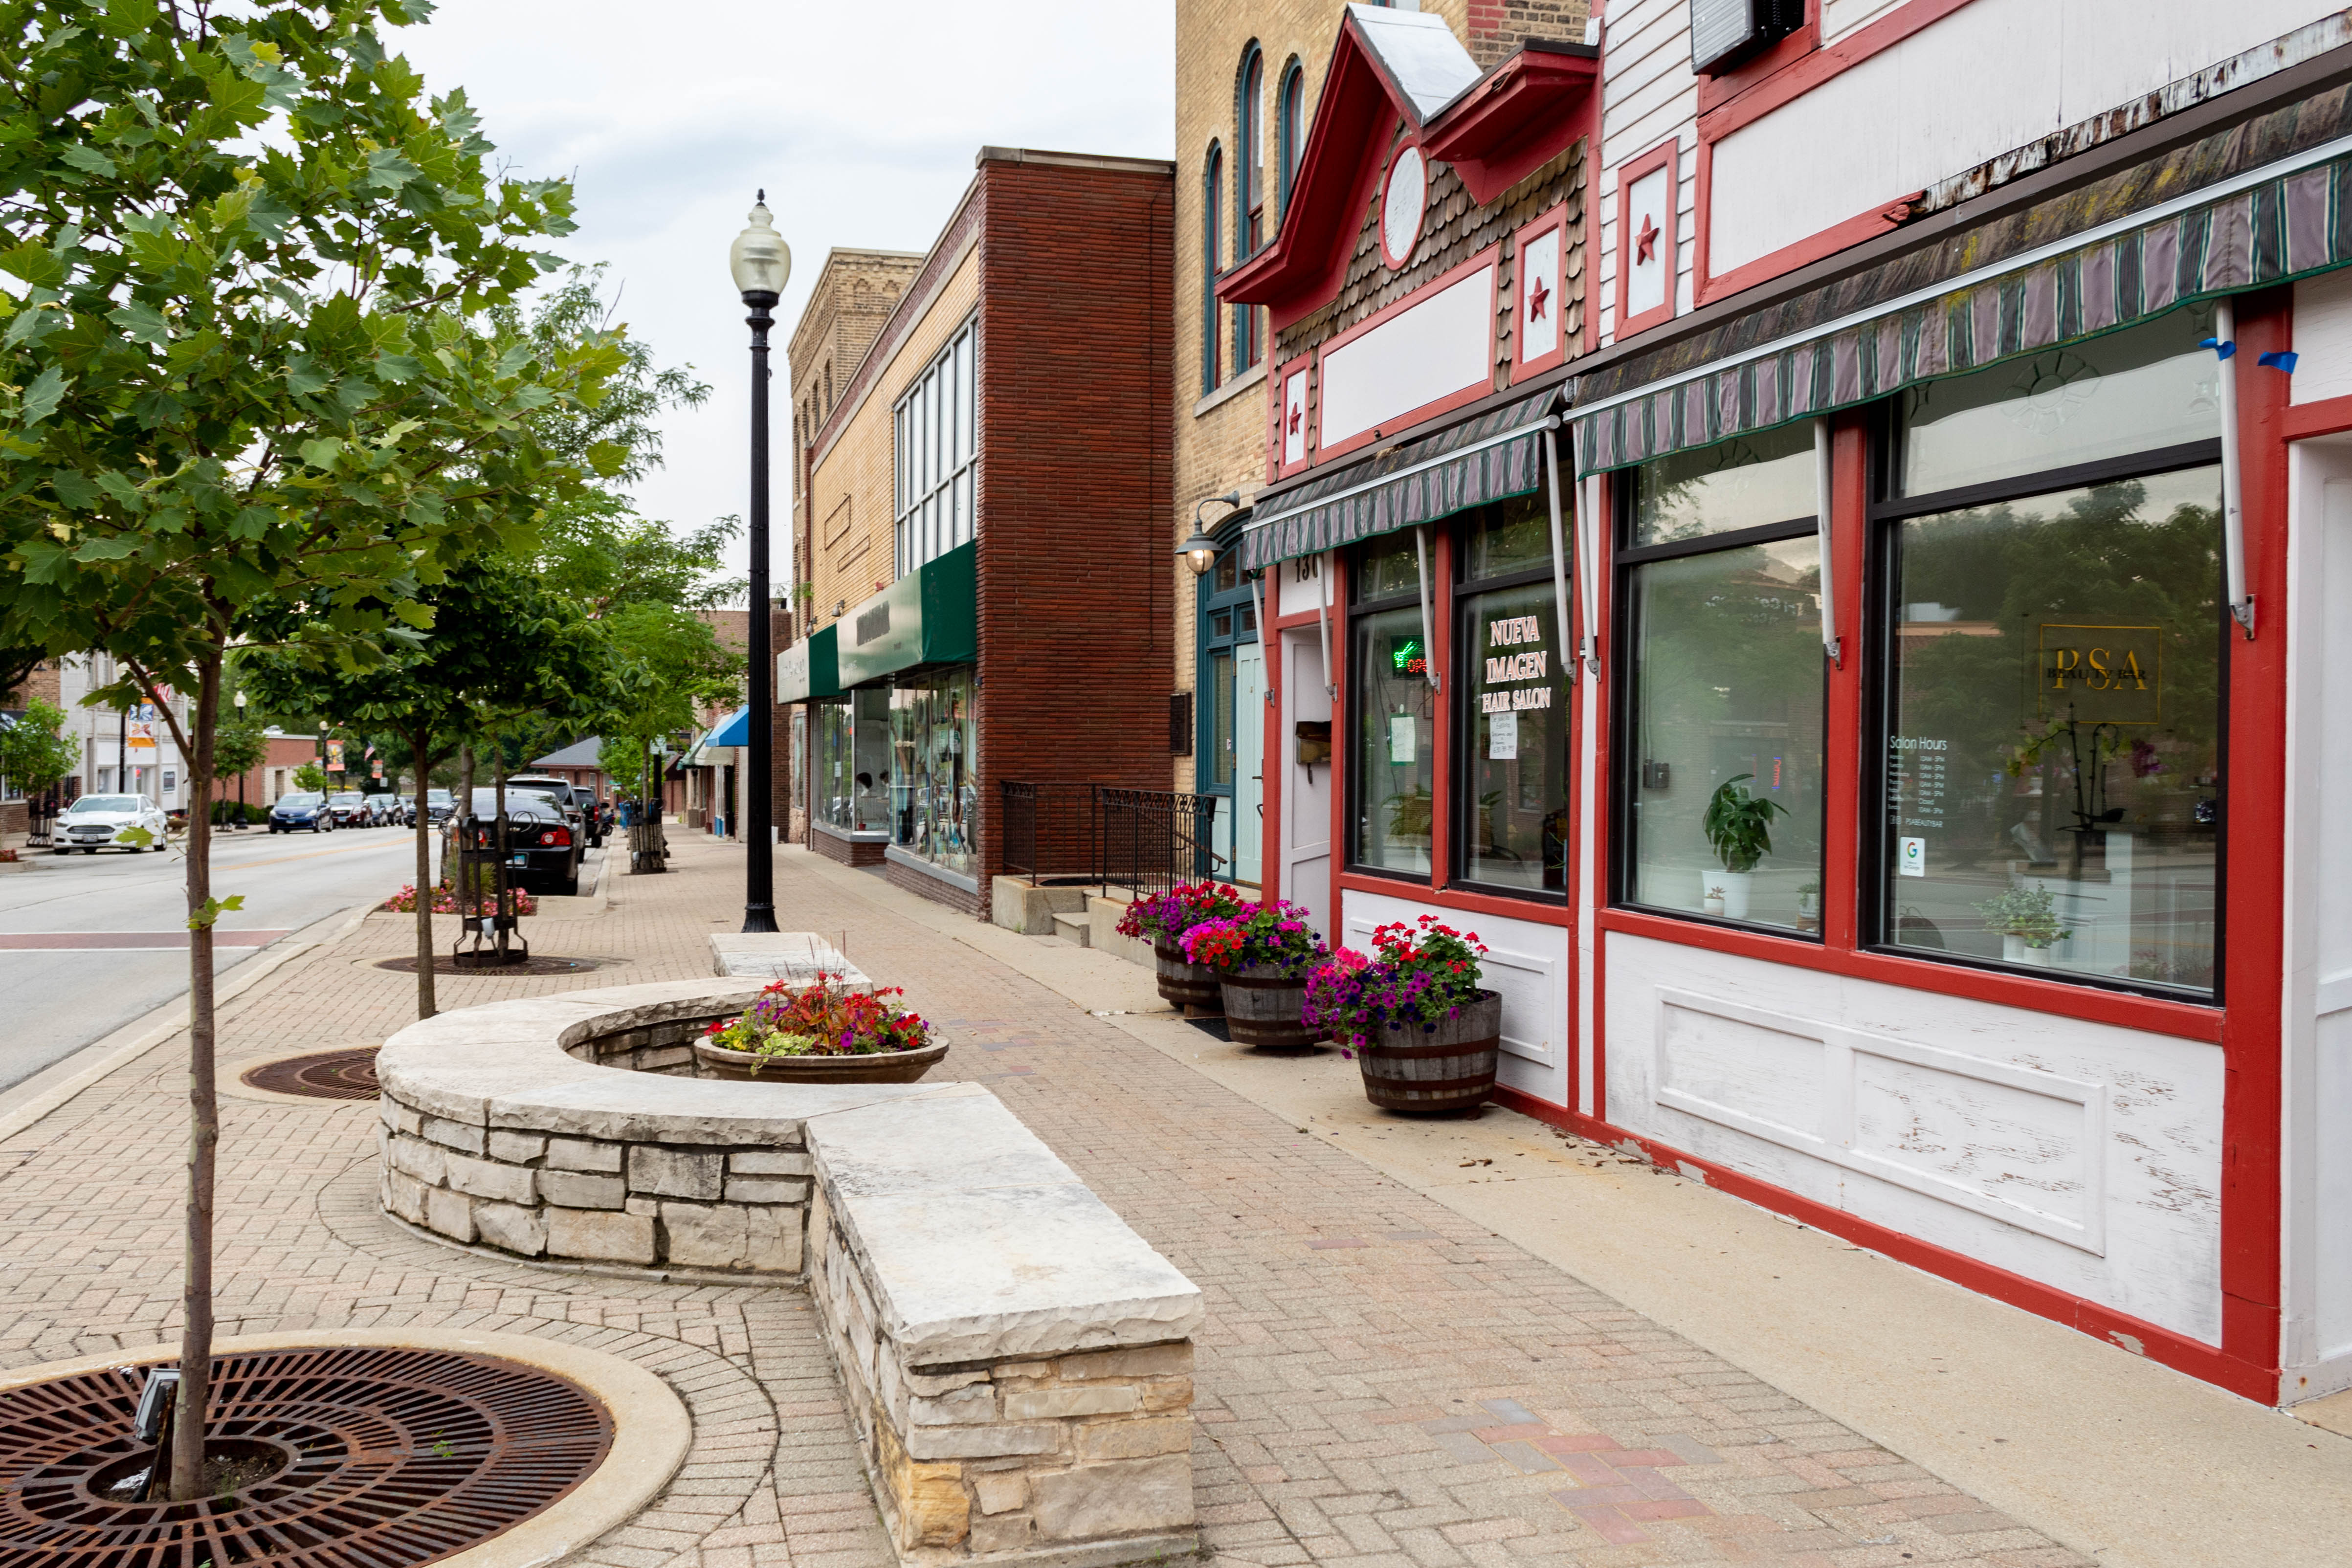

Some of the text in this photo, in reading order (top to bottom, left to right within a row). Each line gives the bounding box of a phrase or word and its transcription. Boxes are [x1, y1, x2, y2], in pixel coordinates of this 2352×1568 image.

[1490, 616, 1540, 646] NUEVA
[1407, 659, 1427, 673] OPE
[1486, 651, 1547, 684] IMAGEN
[2047, 668, 2147, 680] BEAUTY BAR
[2052, 648, 2148, 690] PSA
[1482, 687, 1552, 713] HAIR SALON
[1889, 735, 1947, 751] Salon Hours
[1908, 842, 1917, 858] G
